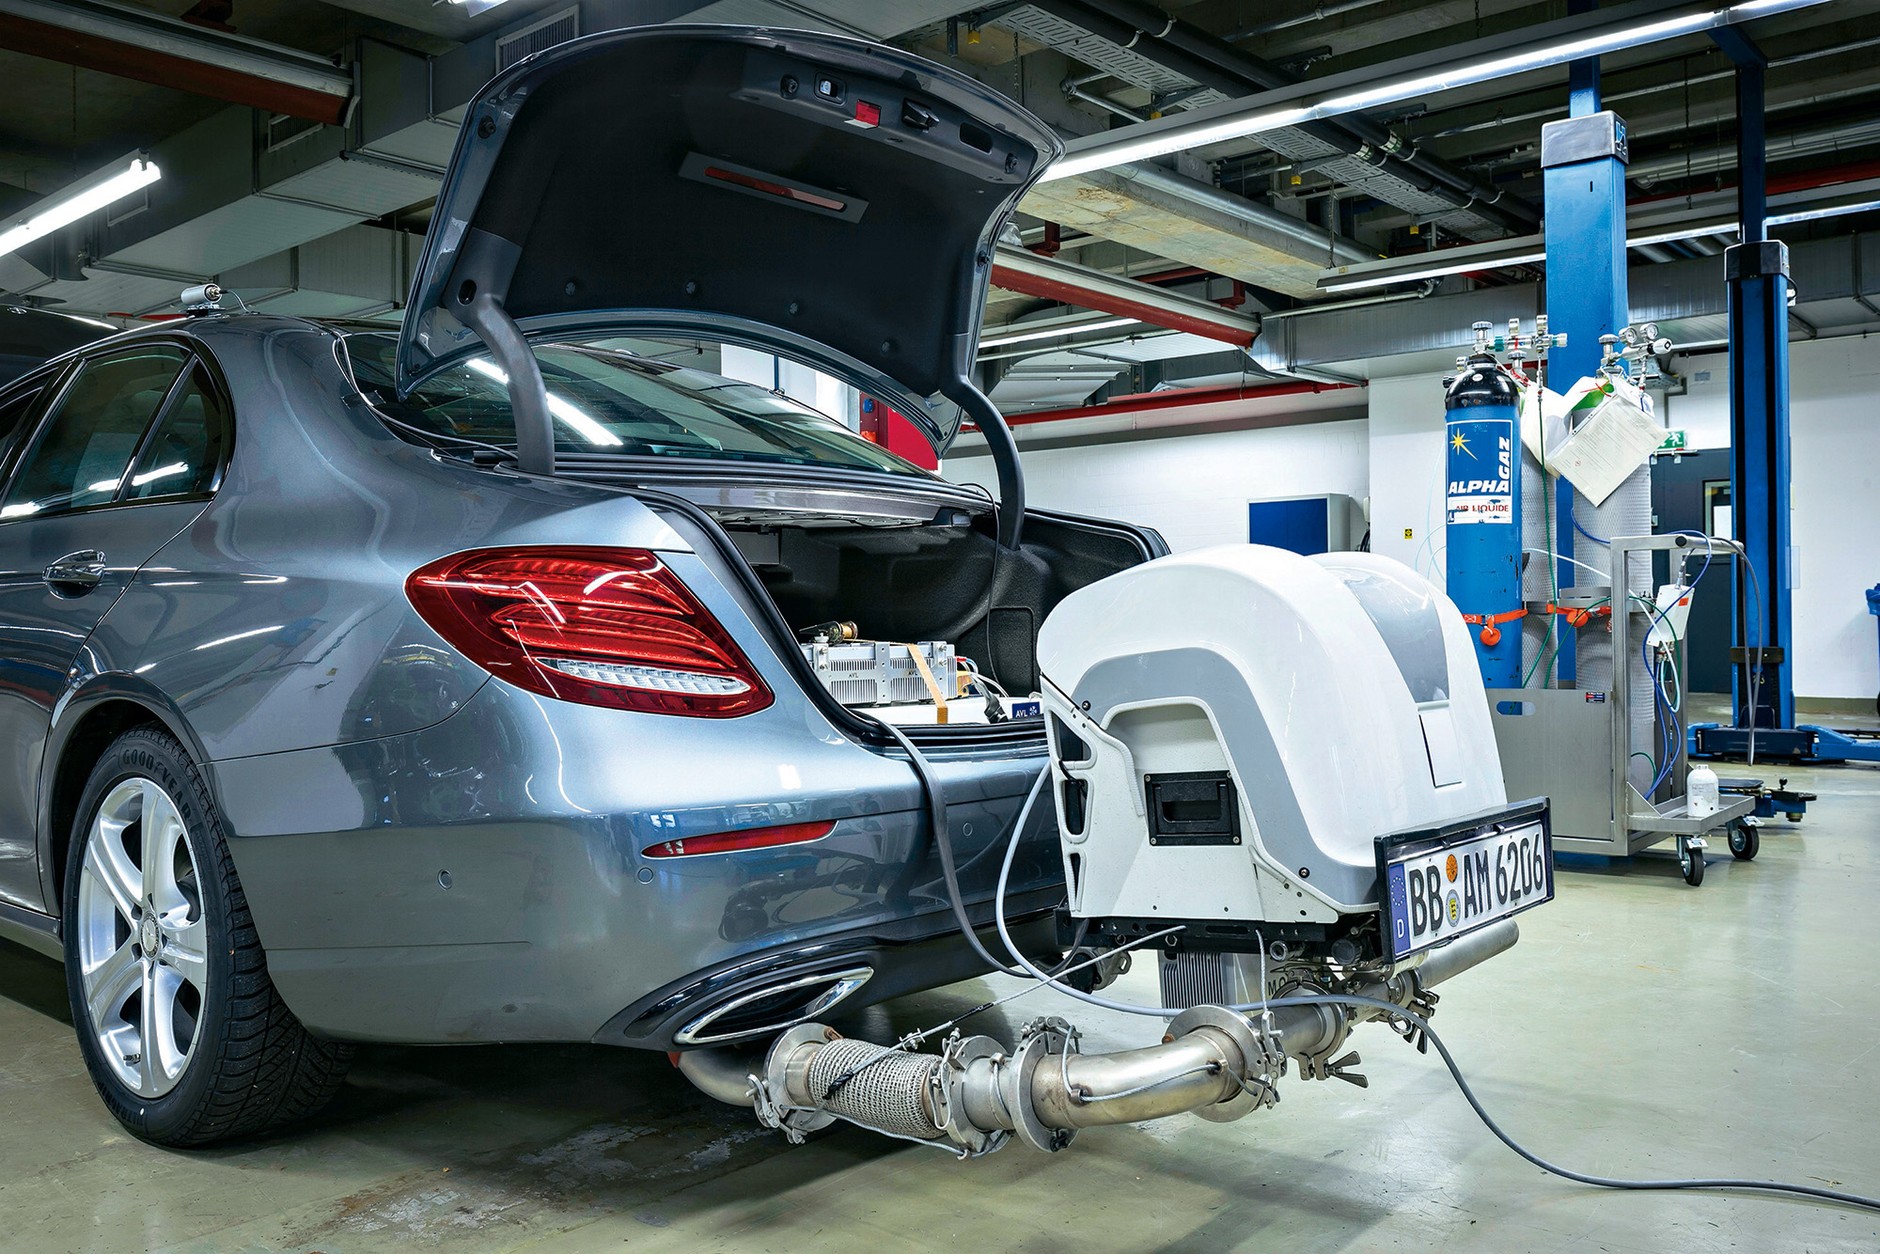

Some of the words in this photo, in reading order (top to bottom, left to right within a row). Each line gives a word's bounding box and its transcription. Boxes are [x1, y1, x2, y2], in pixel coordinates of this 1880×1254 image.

[1498, 436, 1510, 480] GAZ
[1448, 480, 1509, 494] ALPHA
[1472, 504, 1509, 512] LIQUIDE
[1015, 709, 1028, 718] AVL
[1408, 864, 1444, 937] BB
[1464, 849, 1493, 919] AM
[1495, 833, 1544, 906] 6206
[1397, 919, 1405, 938] D
